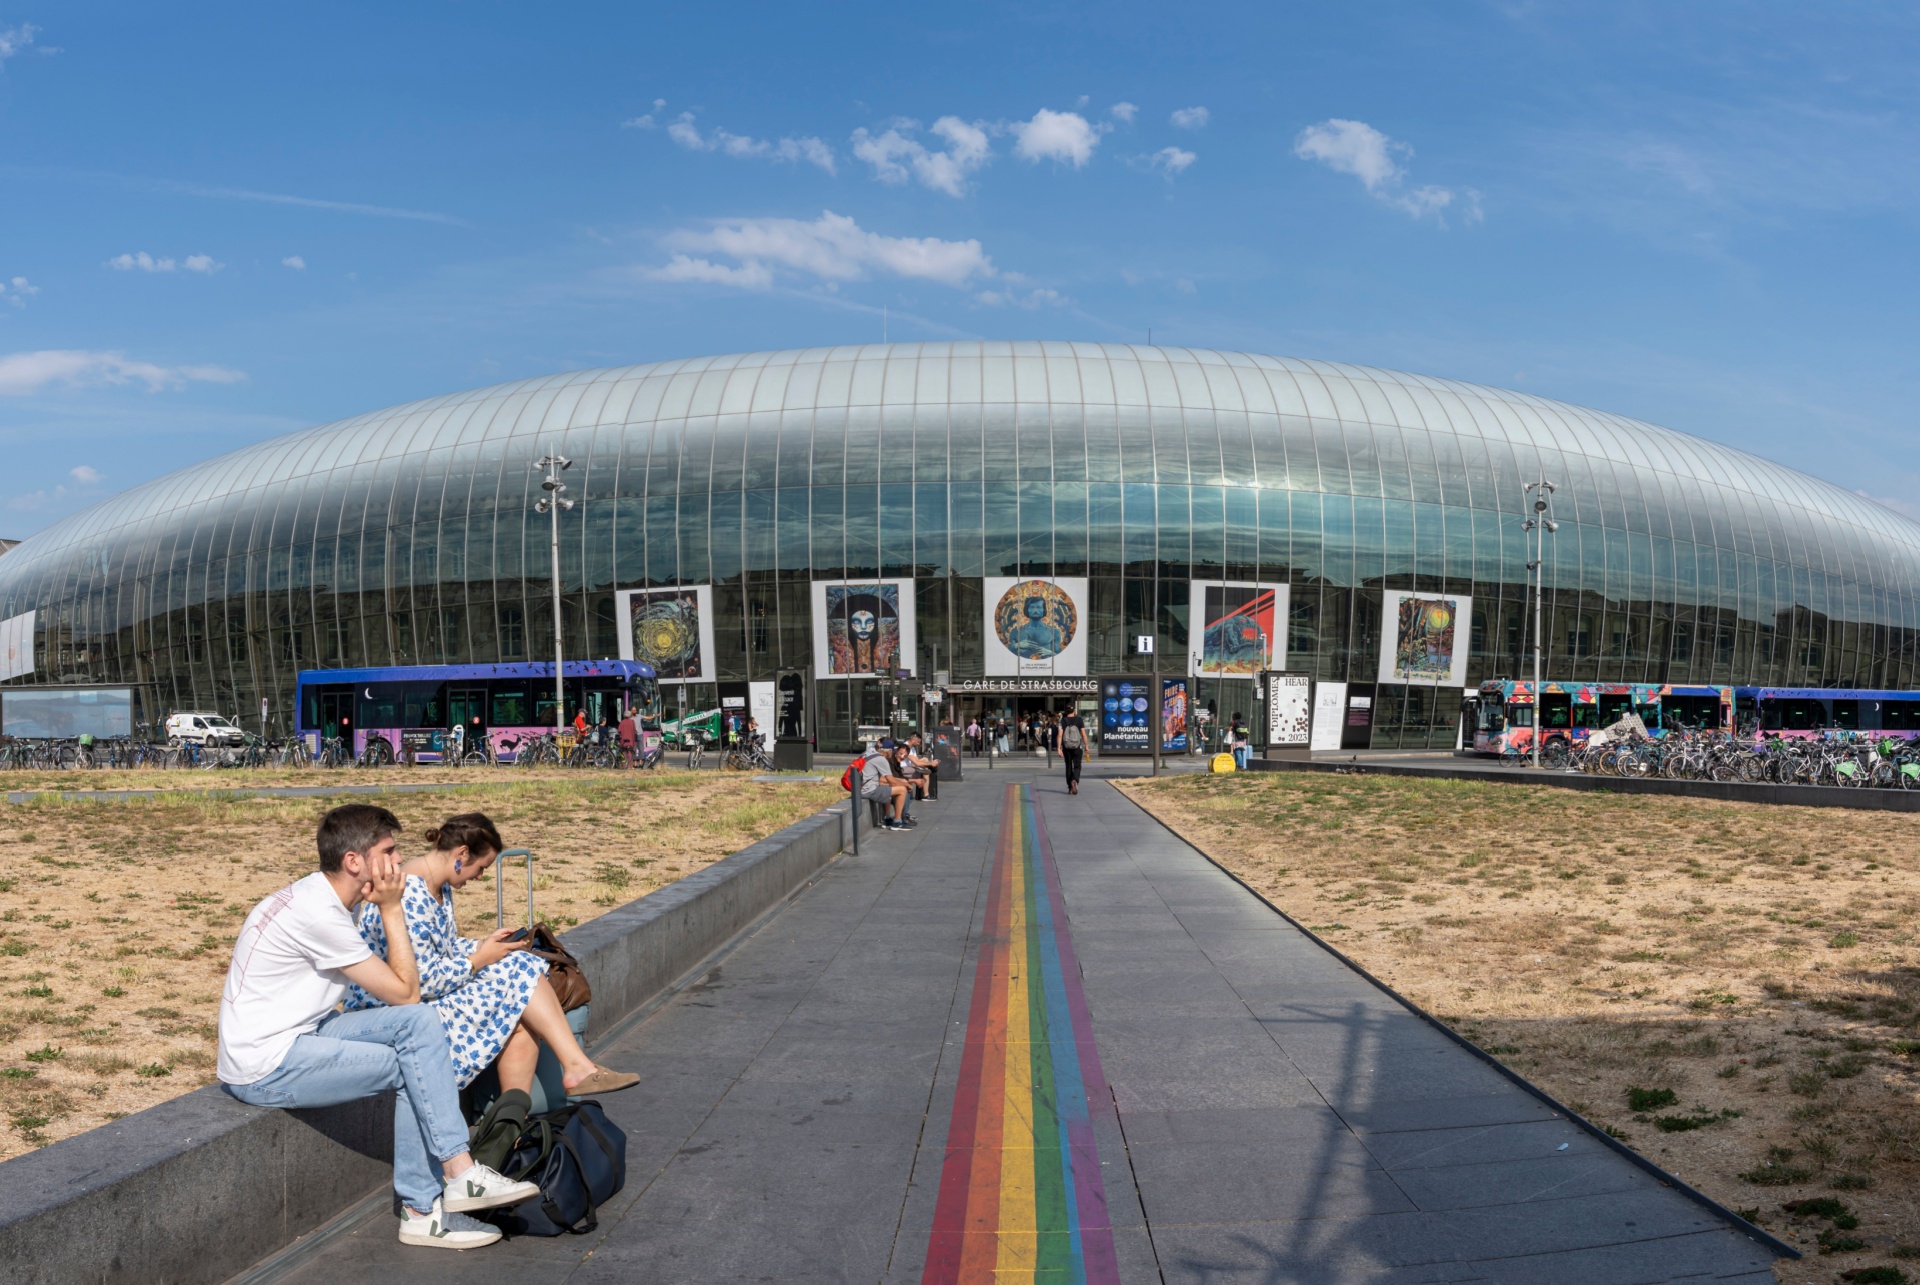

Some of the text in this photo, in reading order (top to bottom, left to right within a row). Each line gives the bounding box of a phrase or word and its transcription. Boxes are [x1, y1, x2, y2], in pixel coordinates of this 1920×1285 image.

[963, 680, 1098, 690] GARE DE STRASBOURG
[1285, 677, 1308, 687] HEAR
[1104, 732, 1149, 740] Planétarium
[1288, 733, 1307, 741] 2023
